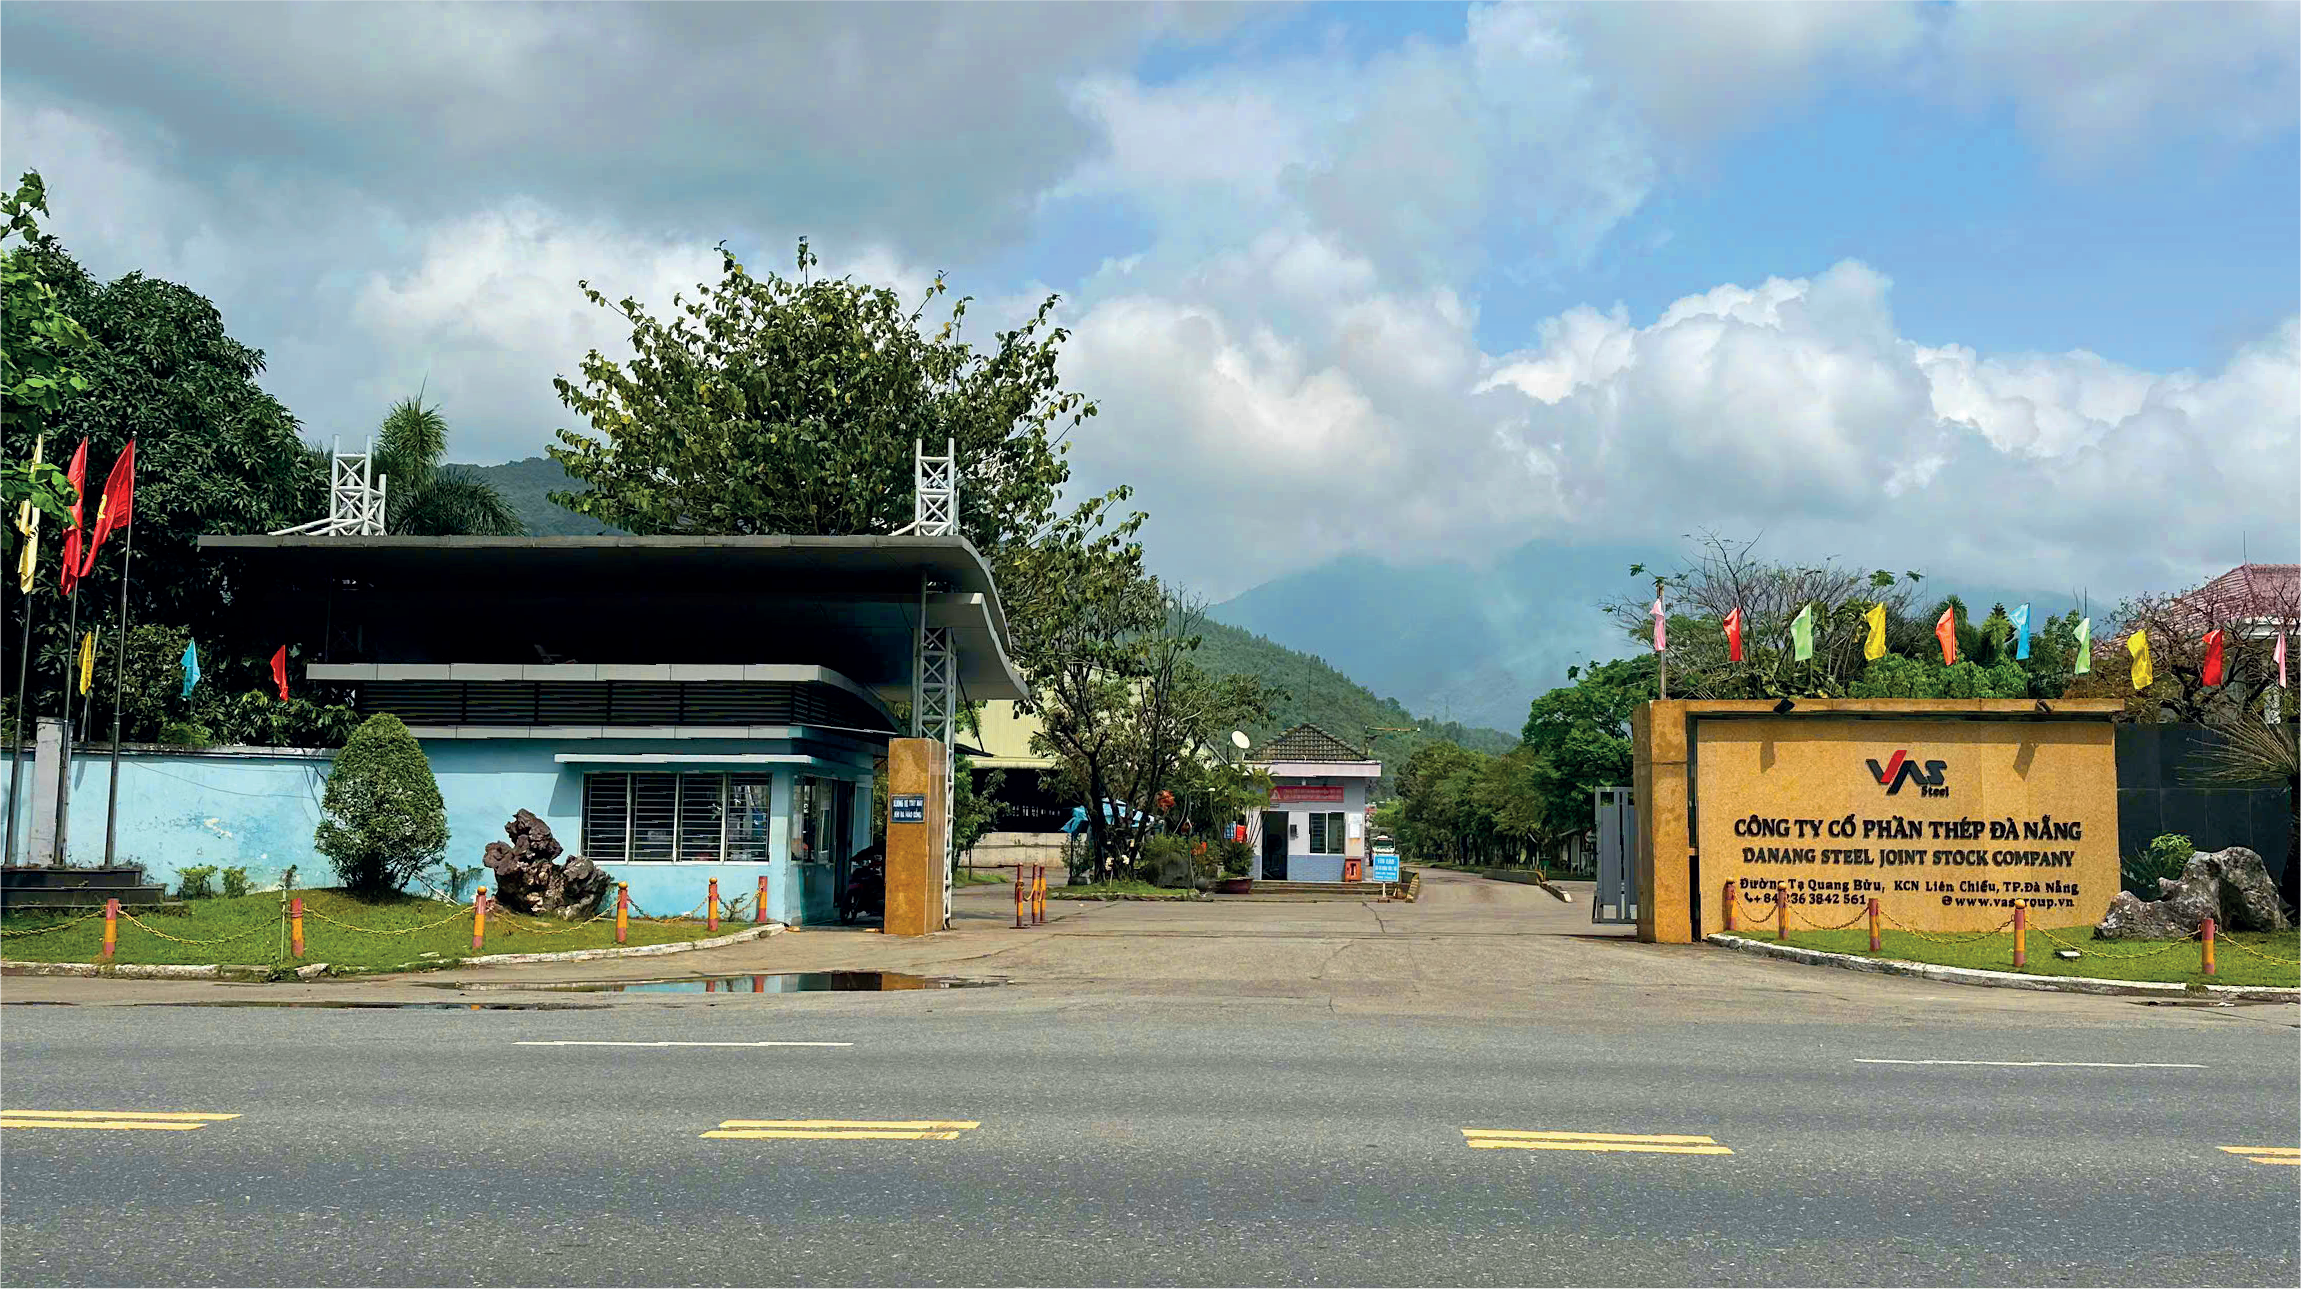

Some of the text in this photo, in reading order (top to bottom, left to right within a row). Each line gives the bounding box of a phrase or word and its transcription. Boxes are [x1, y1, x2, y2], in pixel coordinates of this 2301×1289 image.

[1865, 750, 1948, 796] VAS
[1921, 785, 1949, 798] Steel
[1734, 814, 1790, 837] CÔNG
[1794, 819, 1822, 838] TY
[1863, 815, 1923, 841] PHẦN
[1929, 816, 1986, 840] THÉP
[1990, 817, 2021, 841] ĐÀ
[1742, 846, 2076, 867] DANANG STEEL JOINT STOCK COMPANY
[1787, 878, 1804, 891] Tạ
[1807, 878, 1849, 892] Quang
[1894, 880, 1919, 892] KCN
[1925, 881, 1955, 893] Liên
[2003, 881, 2042, 893] TP.Đà
[1809, 893, 1839, 905] 3842
[1844, 894, 1866, 905] 561
[1956, 897, 2075, 909] www.vasroup.vn
